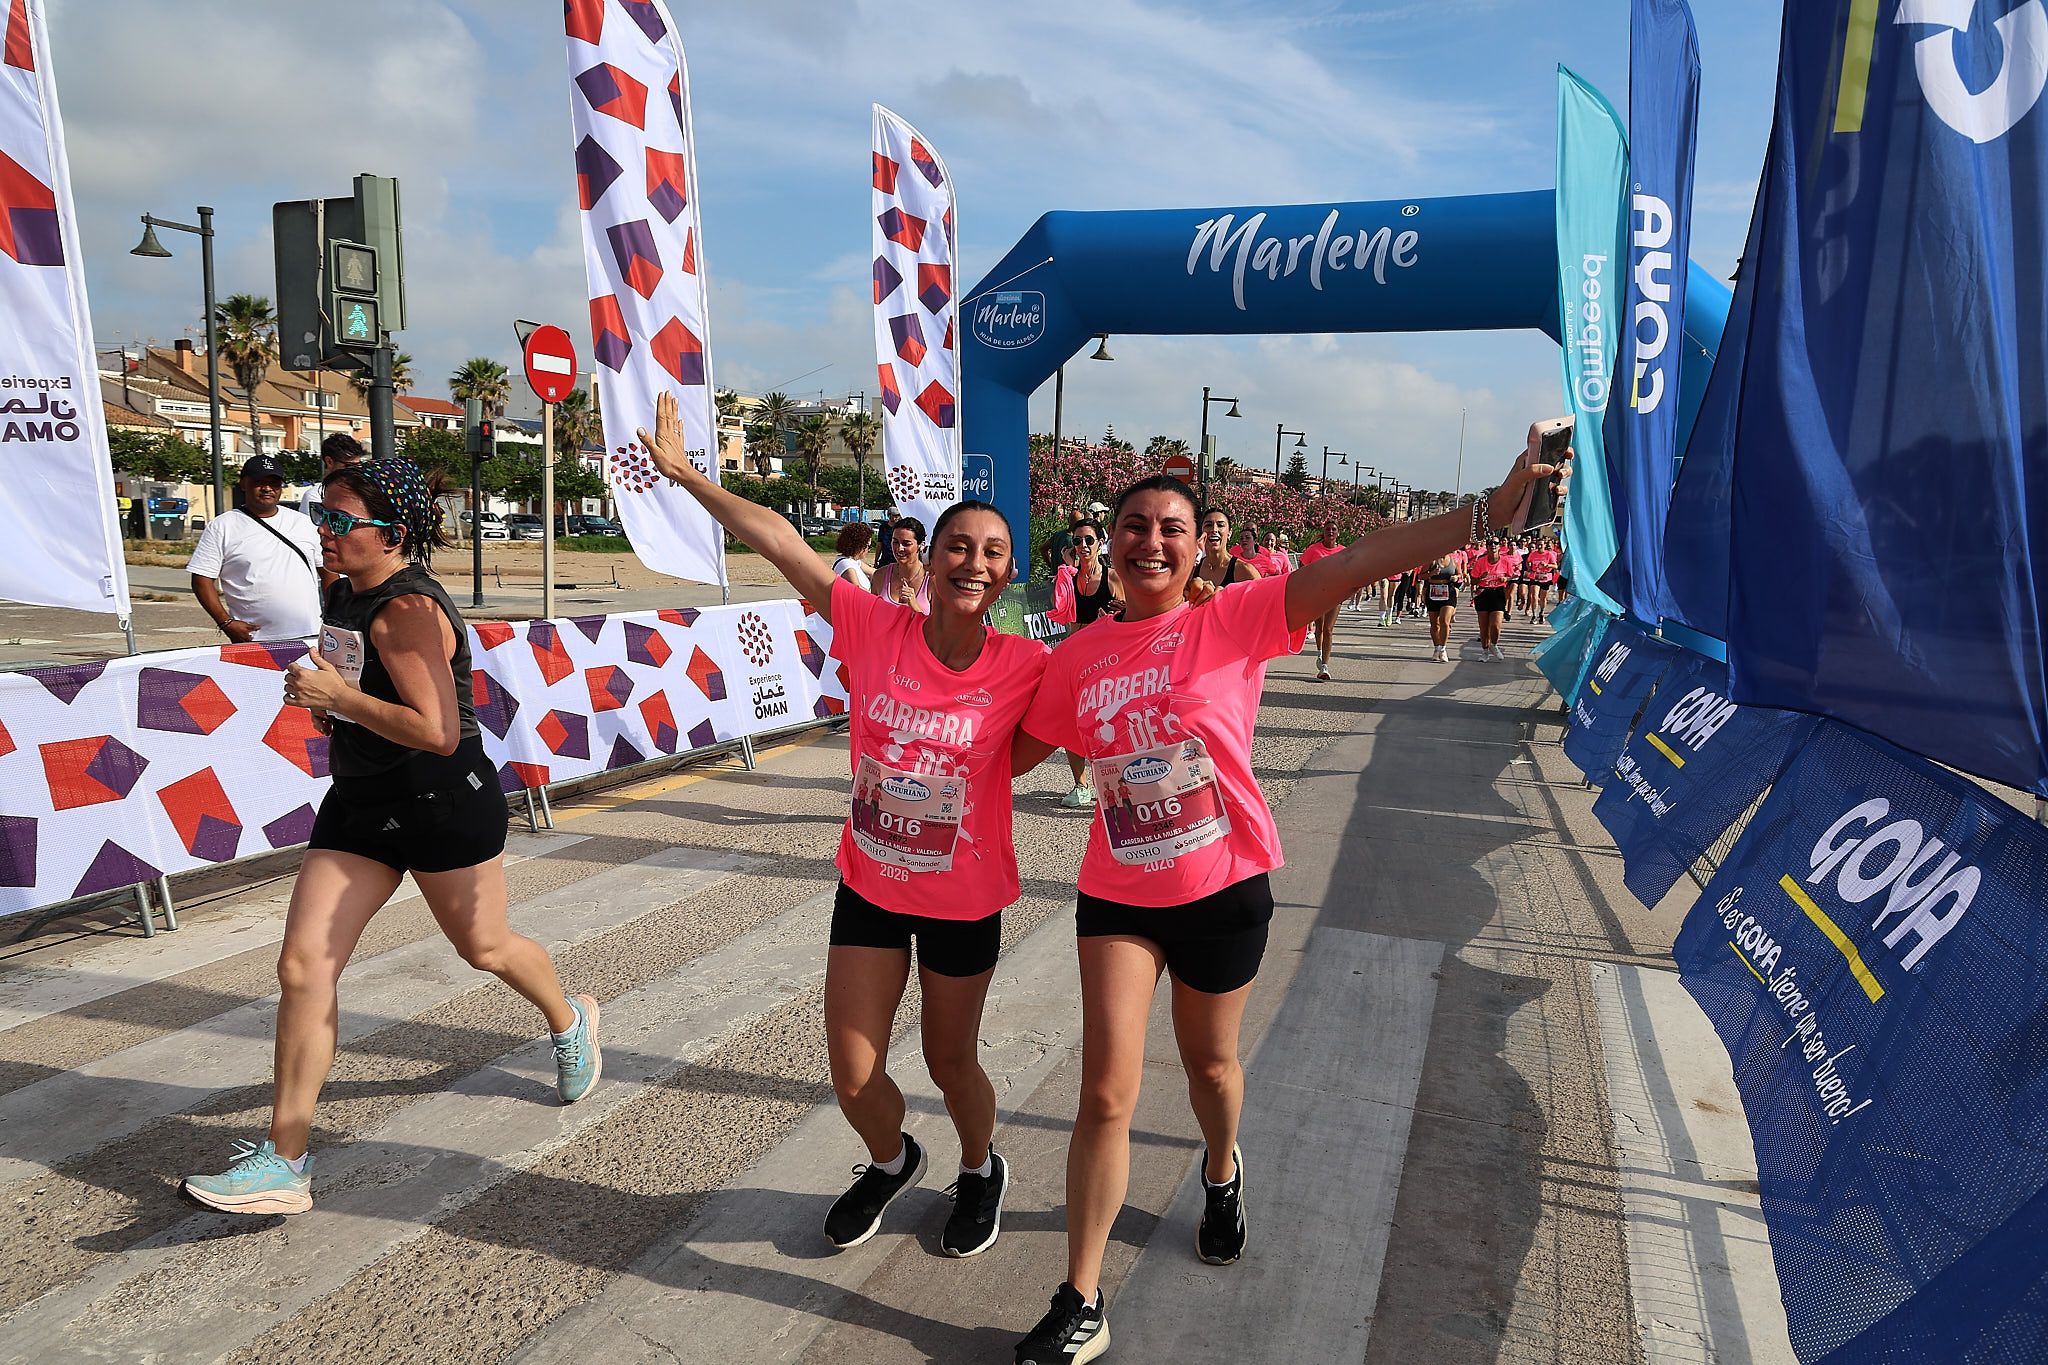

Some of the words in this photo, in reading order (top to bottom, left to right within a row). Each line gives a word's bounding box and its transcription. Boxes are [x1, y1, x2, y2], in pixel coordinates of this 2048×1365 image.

[1186, 208, 1419, 311] Marlene
[978, 304, 1040, 333] Marlene
[980, 332, 992, 343] HIJA
[1017, 333, 1035, 345] ALPES
[749, 673, 782, 686] Experience
[1078, 664, 1172, 718] CARRERA
[754, 701, 788, 720] OMAN
[868, 692, 973, 748] CARRERA
[1658, 686, 1738, 752] GOYA
[1100, 767, 1120, 777] SUMA
[1126, 765, 1169, 781] ASTURIANA
[884, 781, 927, 798] ASTURIANA
[1136, 797, 1182, 822] 016
[880, 812, 921, 836] 016
[1120, 836, 1145, 847] CARRERA
[1145, 834, 1154, 842] DE
[1154, 832, 1162, 840] LA
[1162, 827, 1184, 839] MUJER
[1187, 814, 1214, 830] VALENCIA
[1152, 820, 1175, 832] 2346
[861, 839, 887, 857] OYSHO
[887, 833, 908, 845] 2672
[1125, 846, 1161, 860] OYSHO
[1184, 827, 1218, 847] Santander
[893, 843, 912, 853] MUJER
[916, 848, 943, 856] VALENCIA
[880, 864, 909, 882] 2026
[906, 859, 941, 868] Santander
[1144, 858, 1175, 873] 2026
[1806, 797, 1982, 972] GOYA
[1723, 910, 1742, 930] es
[1768, 966, 1809, 1018] tiene
[1781, 1011, 1817, 1048] que
[1812, 1044, 1873, 1126] bueno!
